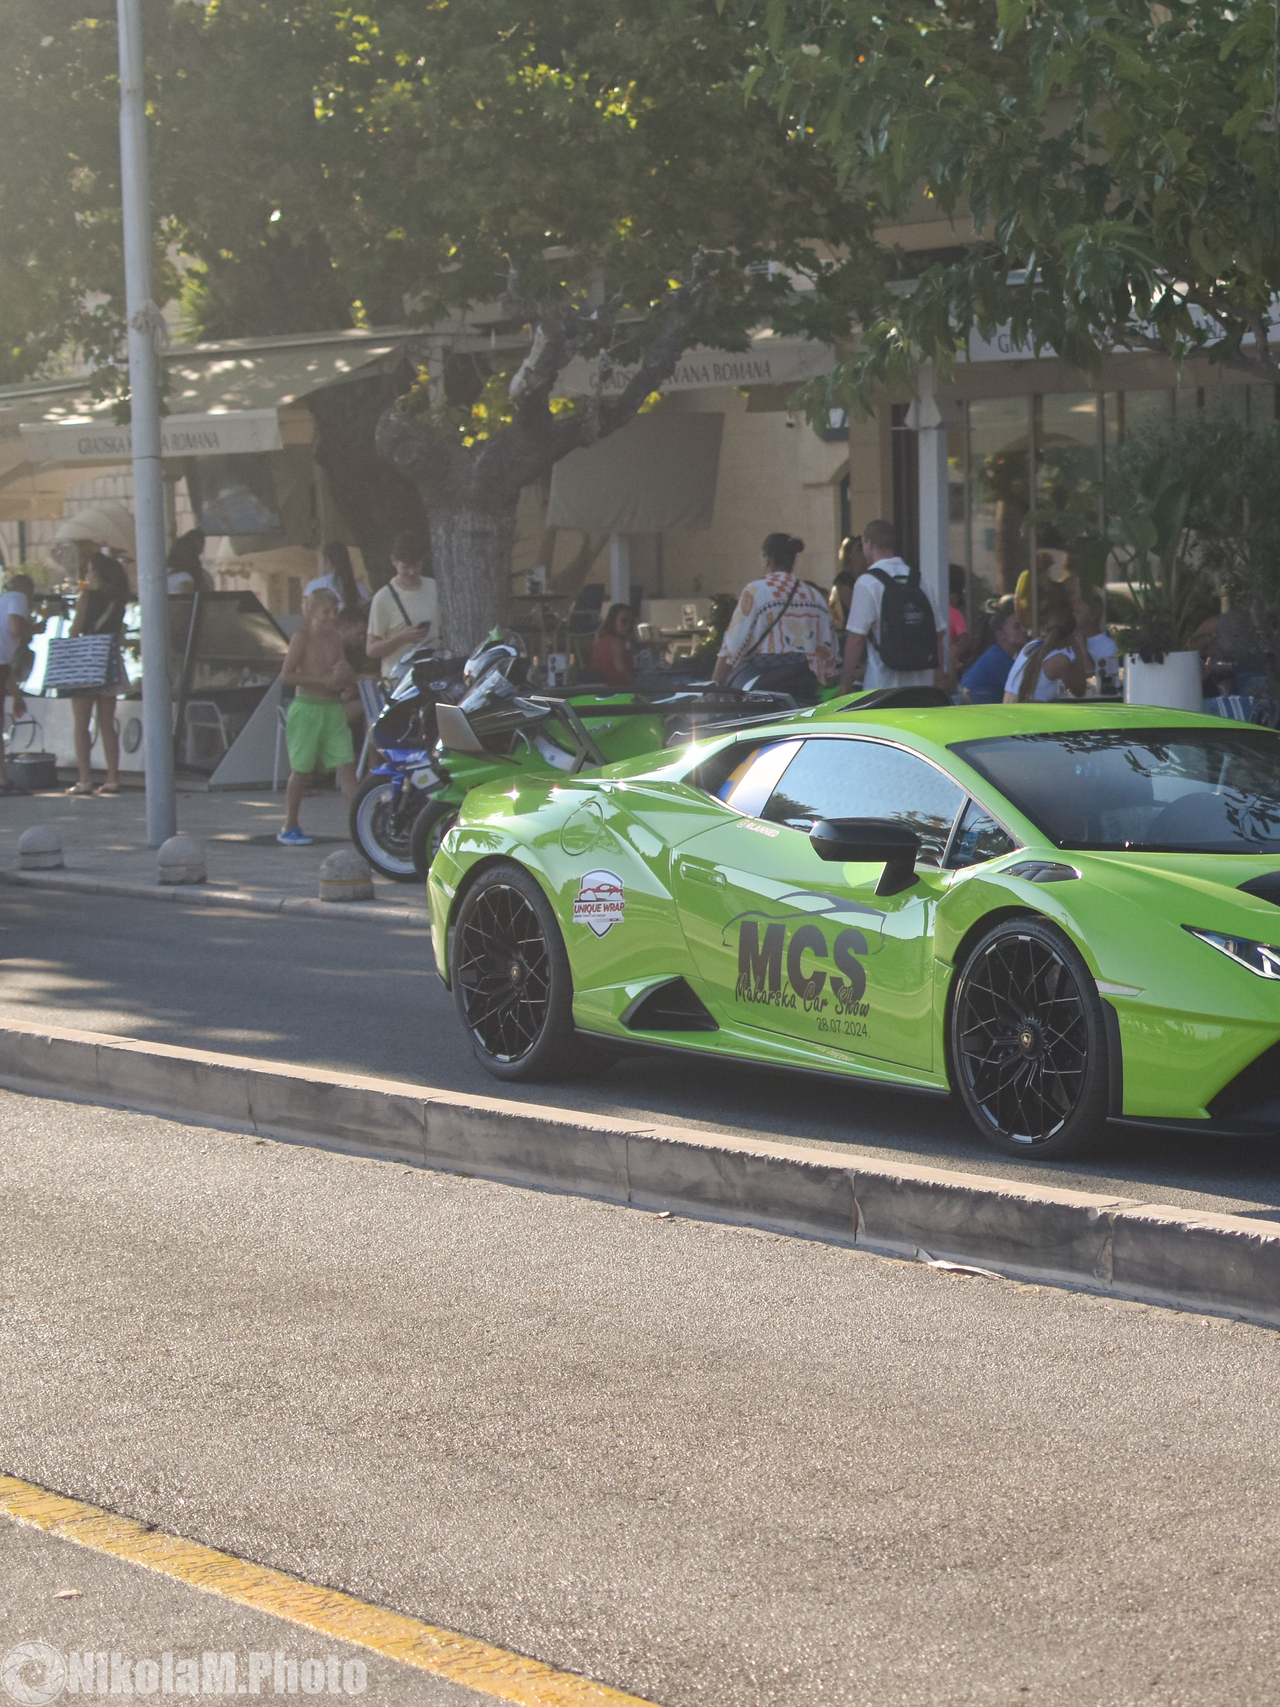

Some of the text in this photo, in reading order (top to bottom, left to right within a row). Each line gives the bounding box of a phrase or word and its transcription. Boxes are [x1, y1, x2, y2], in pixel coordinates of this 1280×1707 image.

[713, 360, 772, 382] ROMANA
[574, 902, 625, 914] UNIQUE WRAP
[738, 920, 869, 1003] MCS
[735, 972, 871, 1017] Makarska Car Show
